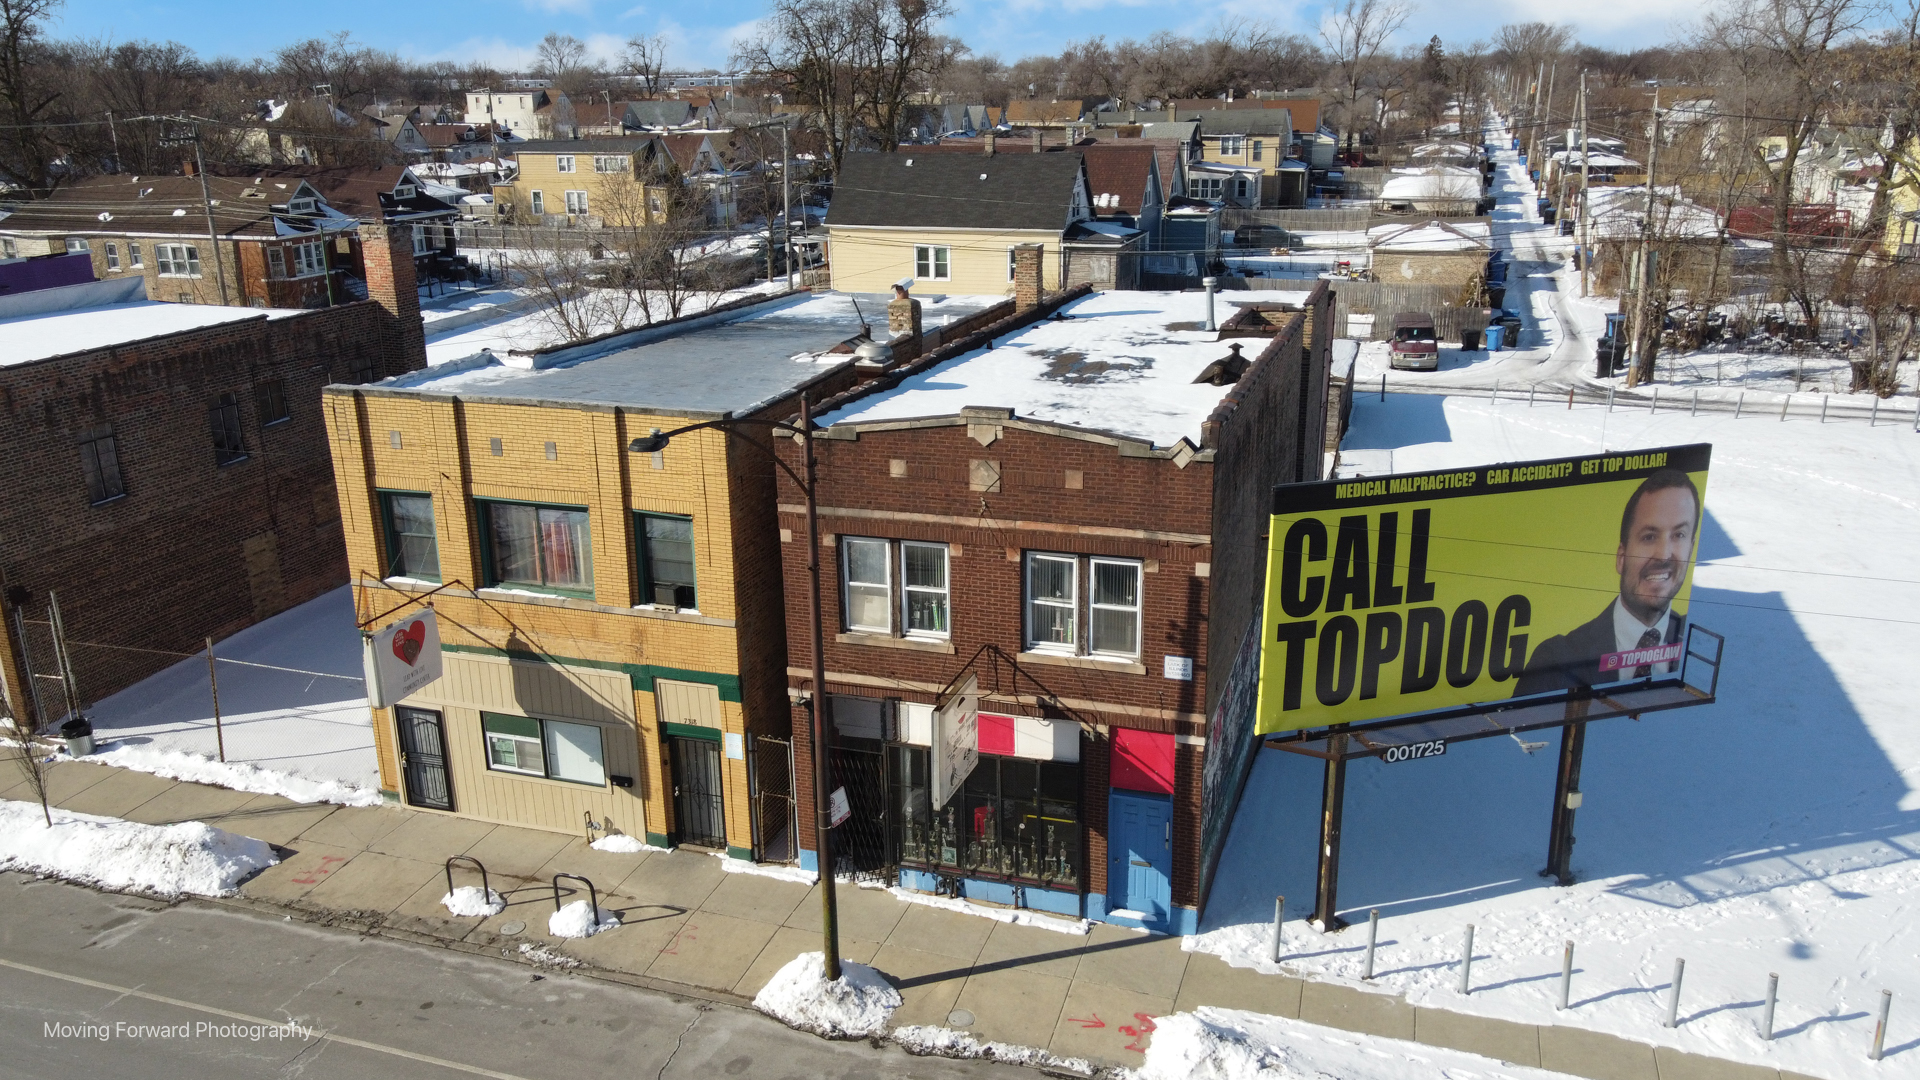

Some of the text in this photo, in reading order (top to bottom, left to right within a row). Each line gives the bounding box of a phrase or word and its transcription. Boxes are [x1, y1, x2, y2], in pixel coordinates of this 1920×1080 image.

[1336, 452, 1668, 499] MEDICAL MALPRACTICE? CAR ACCIDENT? GET TOP DOLLAR!
[1280, 508, 1436, 618] CALL
[1277, 594, 1532, 711] TOPDOG
[1621, 645, 1680, 666] TOPDOGLAW
[1386, 740, 1445, 762] 001725
